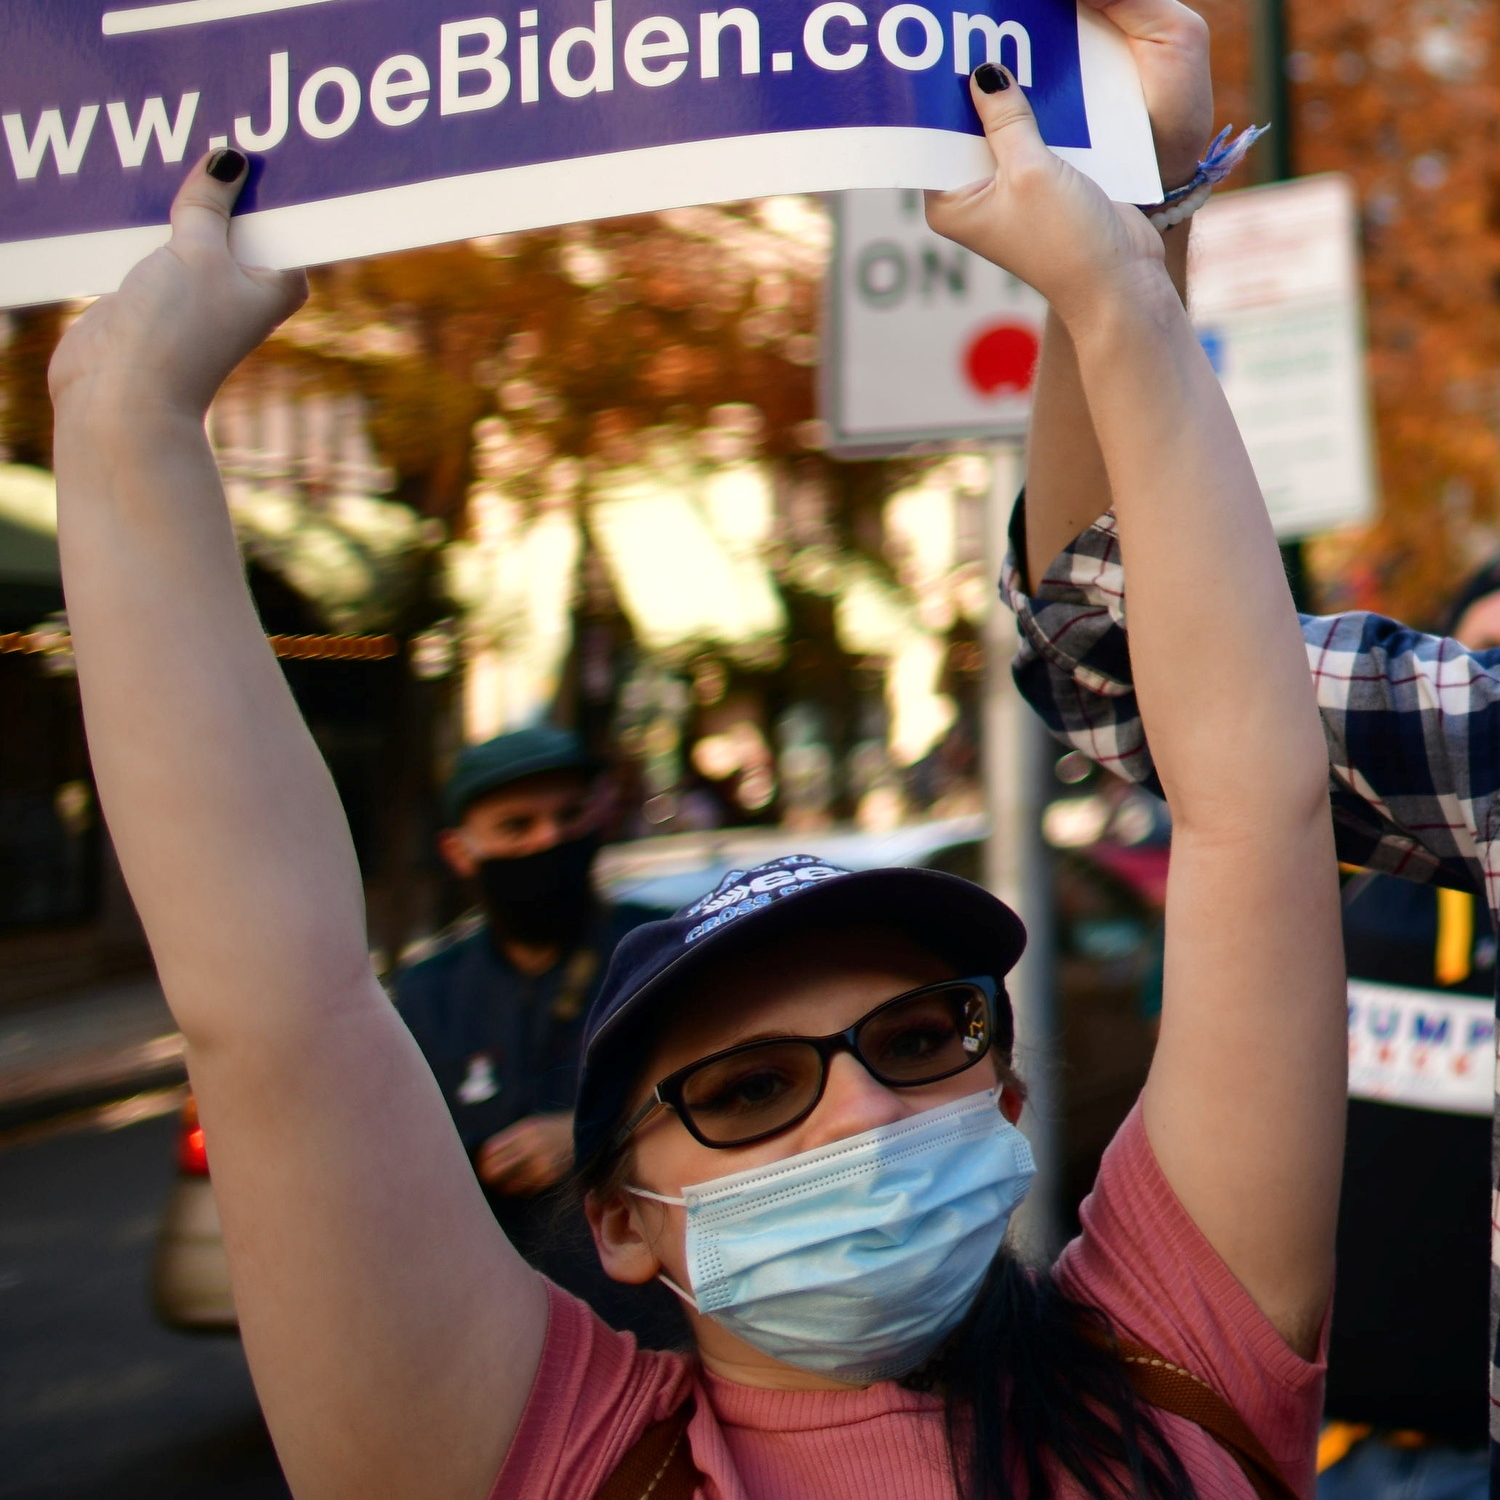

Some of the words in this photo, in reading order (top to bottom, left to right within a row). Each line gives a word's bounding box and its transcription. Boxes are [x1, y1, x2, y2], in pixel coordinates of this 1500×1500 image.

[856, 238, 967, 308] ON
[684, 893, 772, 944] CROSS
[1349, 1000, 1495, 1050] UMP
